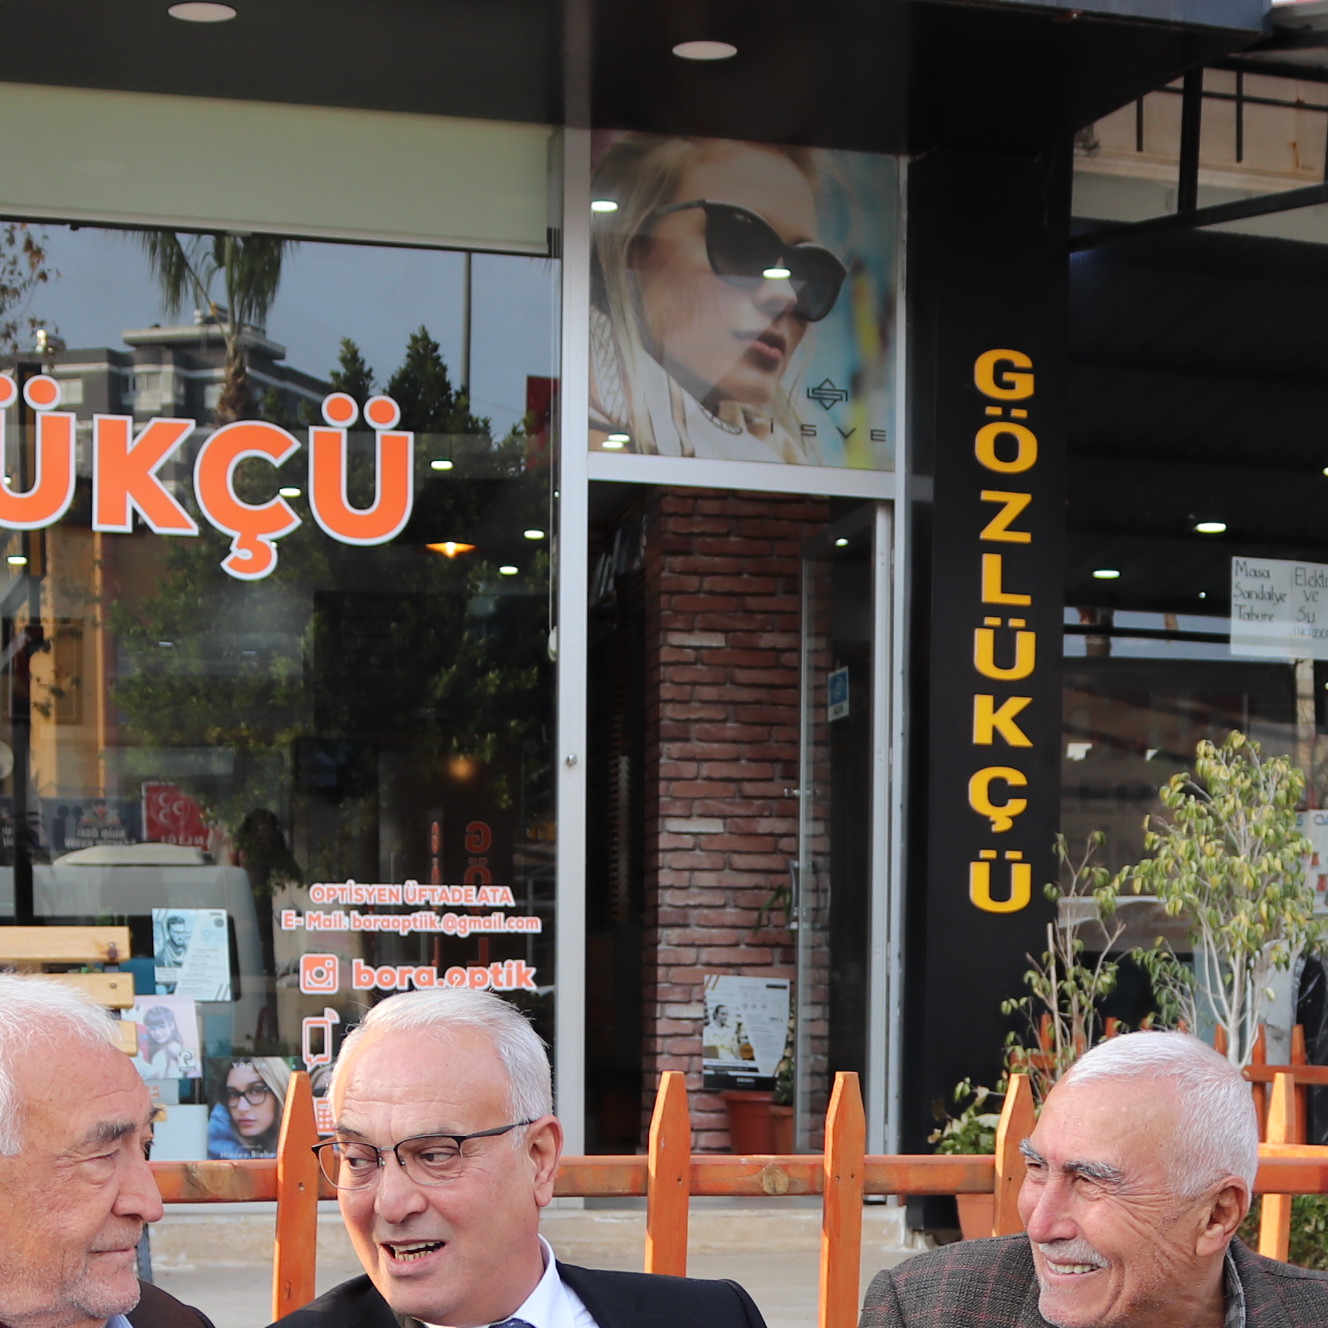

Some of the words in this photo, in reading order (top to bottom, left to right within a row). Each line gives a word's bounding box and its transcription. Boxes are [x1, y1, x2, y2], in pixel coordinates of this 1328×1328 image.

[1234, 560, 1271, 579] Masa
[1233, 582, 1288, 606] Sandalye
[968, 348, 1039, 914] GÖZLÜKÇÜ
[309, 879, 402, 906] OPTİSYEN
[404, 879, 475, 907] ÜFTADE
[475, 885, 516, 907] ATA
[351, 957, 537, 992] bora.optik
